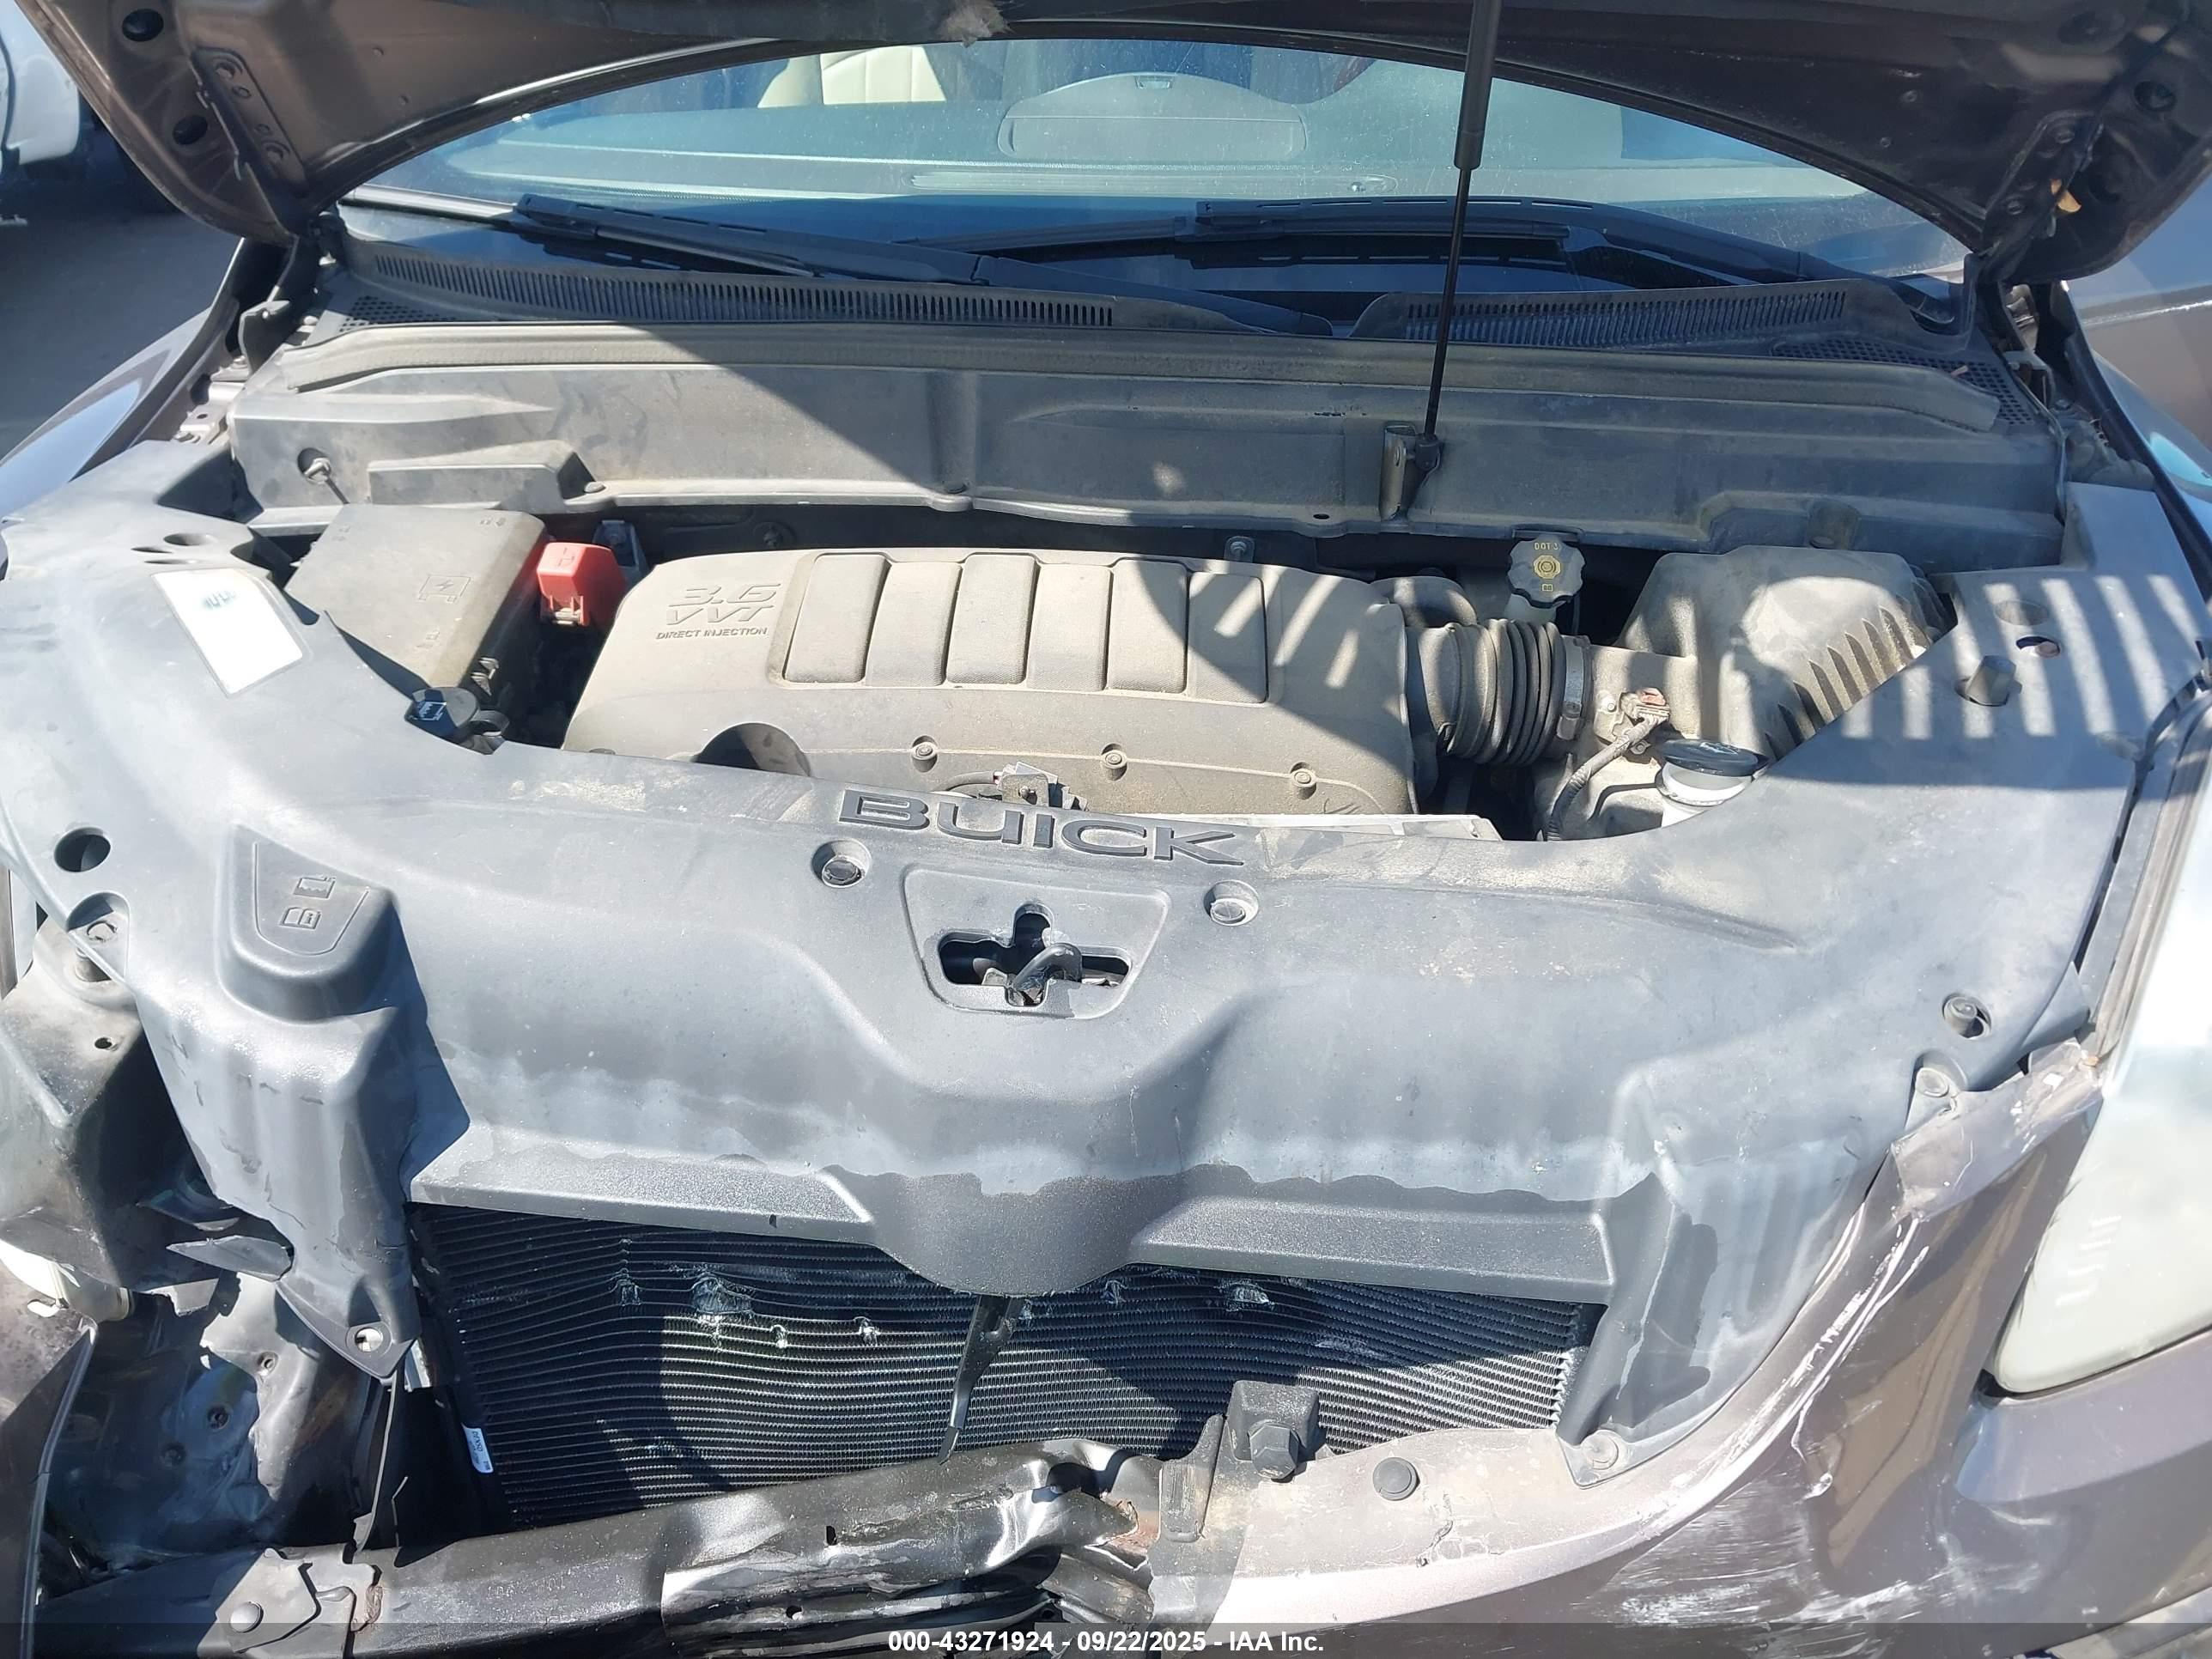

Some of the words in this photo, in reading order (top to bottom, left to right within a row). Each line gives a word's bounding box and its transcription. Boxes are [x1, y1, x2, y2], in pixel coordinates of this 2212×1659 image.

[1534, 542, 1551, 550] DOT
[668, 583, 781, 608] 3.6
[665, 605, 775, 626] VVT
[656, 629, 701, 640] DIRECT
[702, 627, 768, 637] INJECTION
[838, 789, 1244, 866] BUICK
